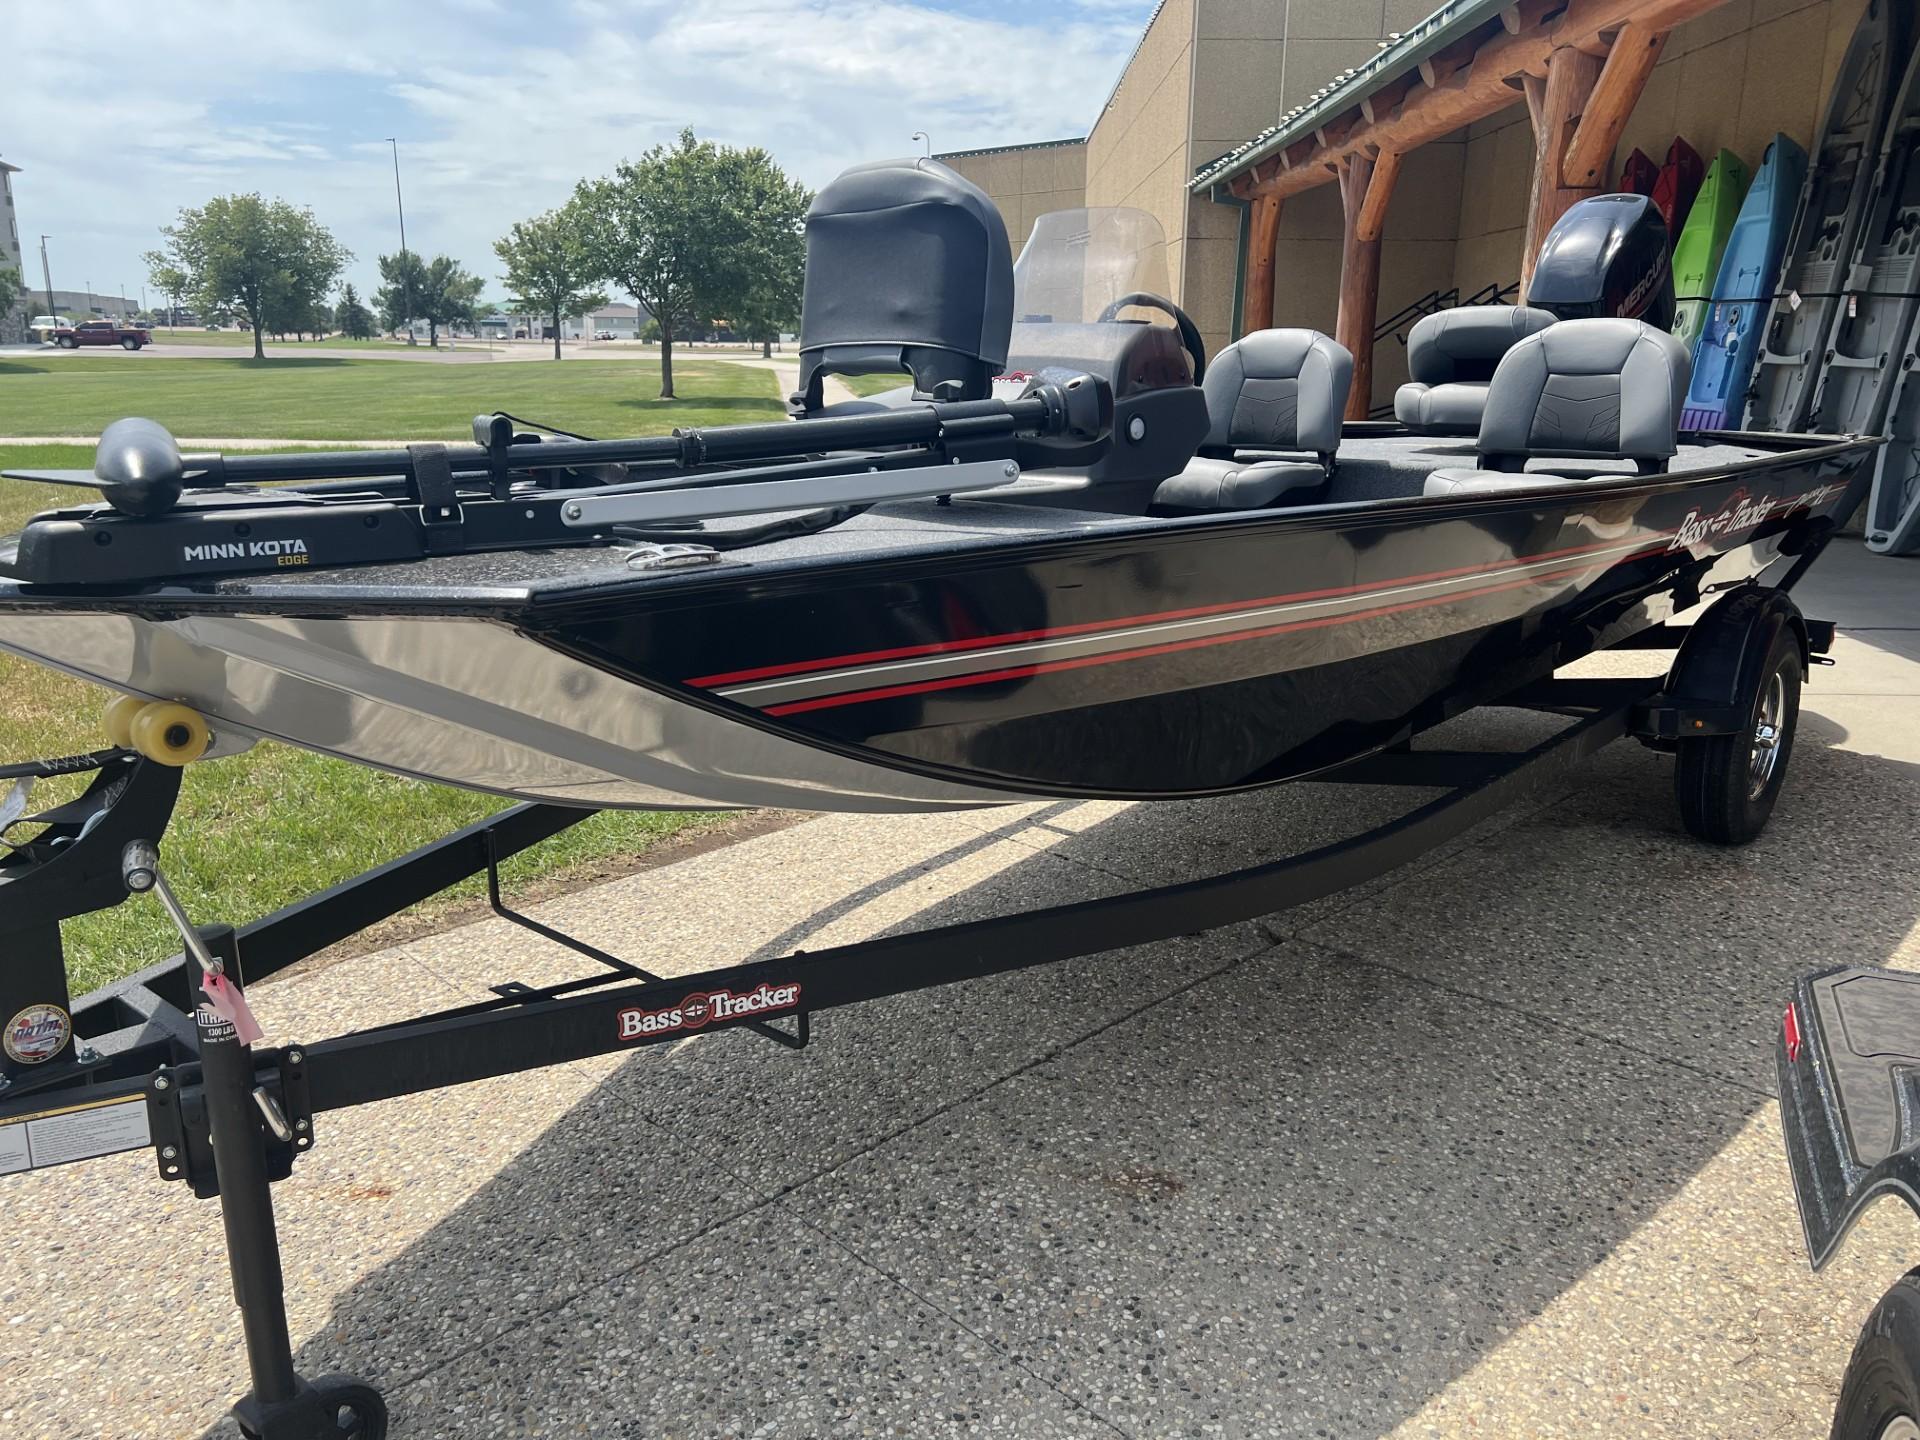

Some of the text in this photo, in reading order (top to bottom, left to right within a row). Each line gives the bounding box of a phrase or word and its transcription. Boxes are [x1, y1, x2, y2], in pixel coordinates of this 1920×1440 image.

[1667, 511, 1714, 550] Bass
[184, 539, 308, 561] MINN KOTA
[277, 554, 309, 566] EDGE
[621, 985, 798, 1037] Bass Tracker
